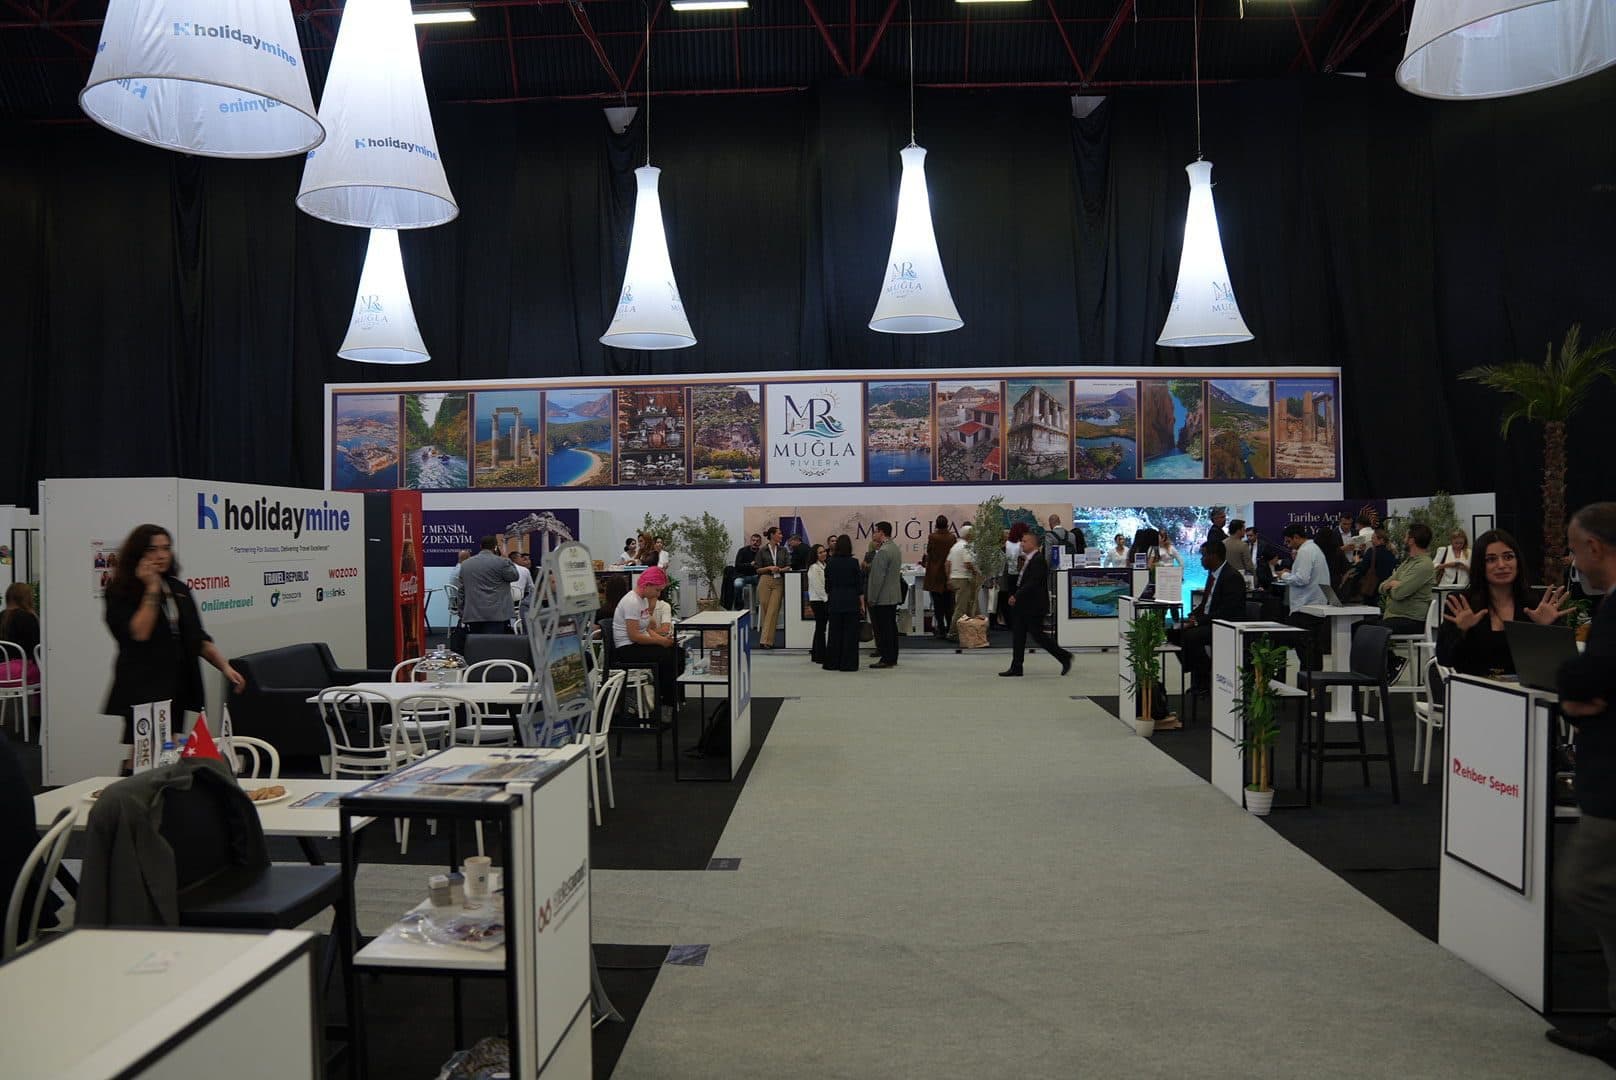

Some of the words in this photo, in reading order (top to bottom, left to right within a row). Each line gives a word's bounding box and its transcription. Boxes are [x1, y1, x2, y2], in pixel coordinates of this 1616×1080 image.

[193, 24, 297, 67] holidaymine
[773, 440, 856, 458] MUĞLA
[790, 459, 840, 467] RIVIERA
[224, 496, 350, 539] holidaymine
[1288, 512, 1320, 522] Tarihe
[1322, 512, 1341, 525] Açıl
[430, 534, 475, 544] DENEYİM.
[201, 596, 253, 612] Onlinetravel
[1453, 758, 1487, 785] Rehber
[1489, 776, 1519, 798] Sepeti
